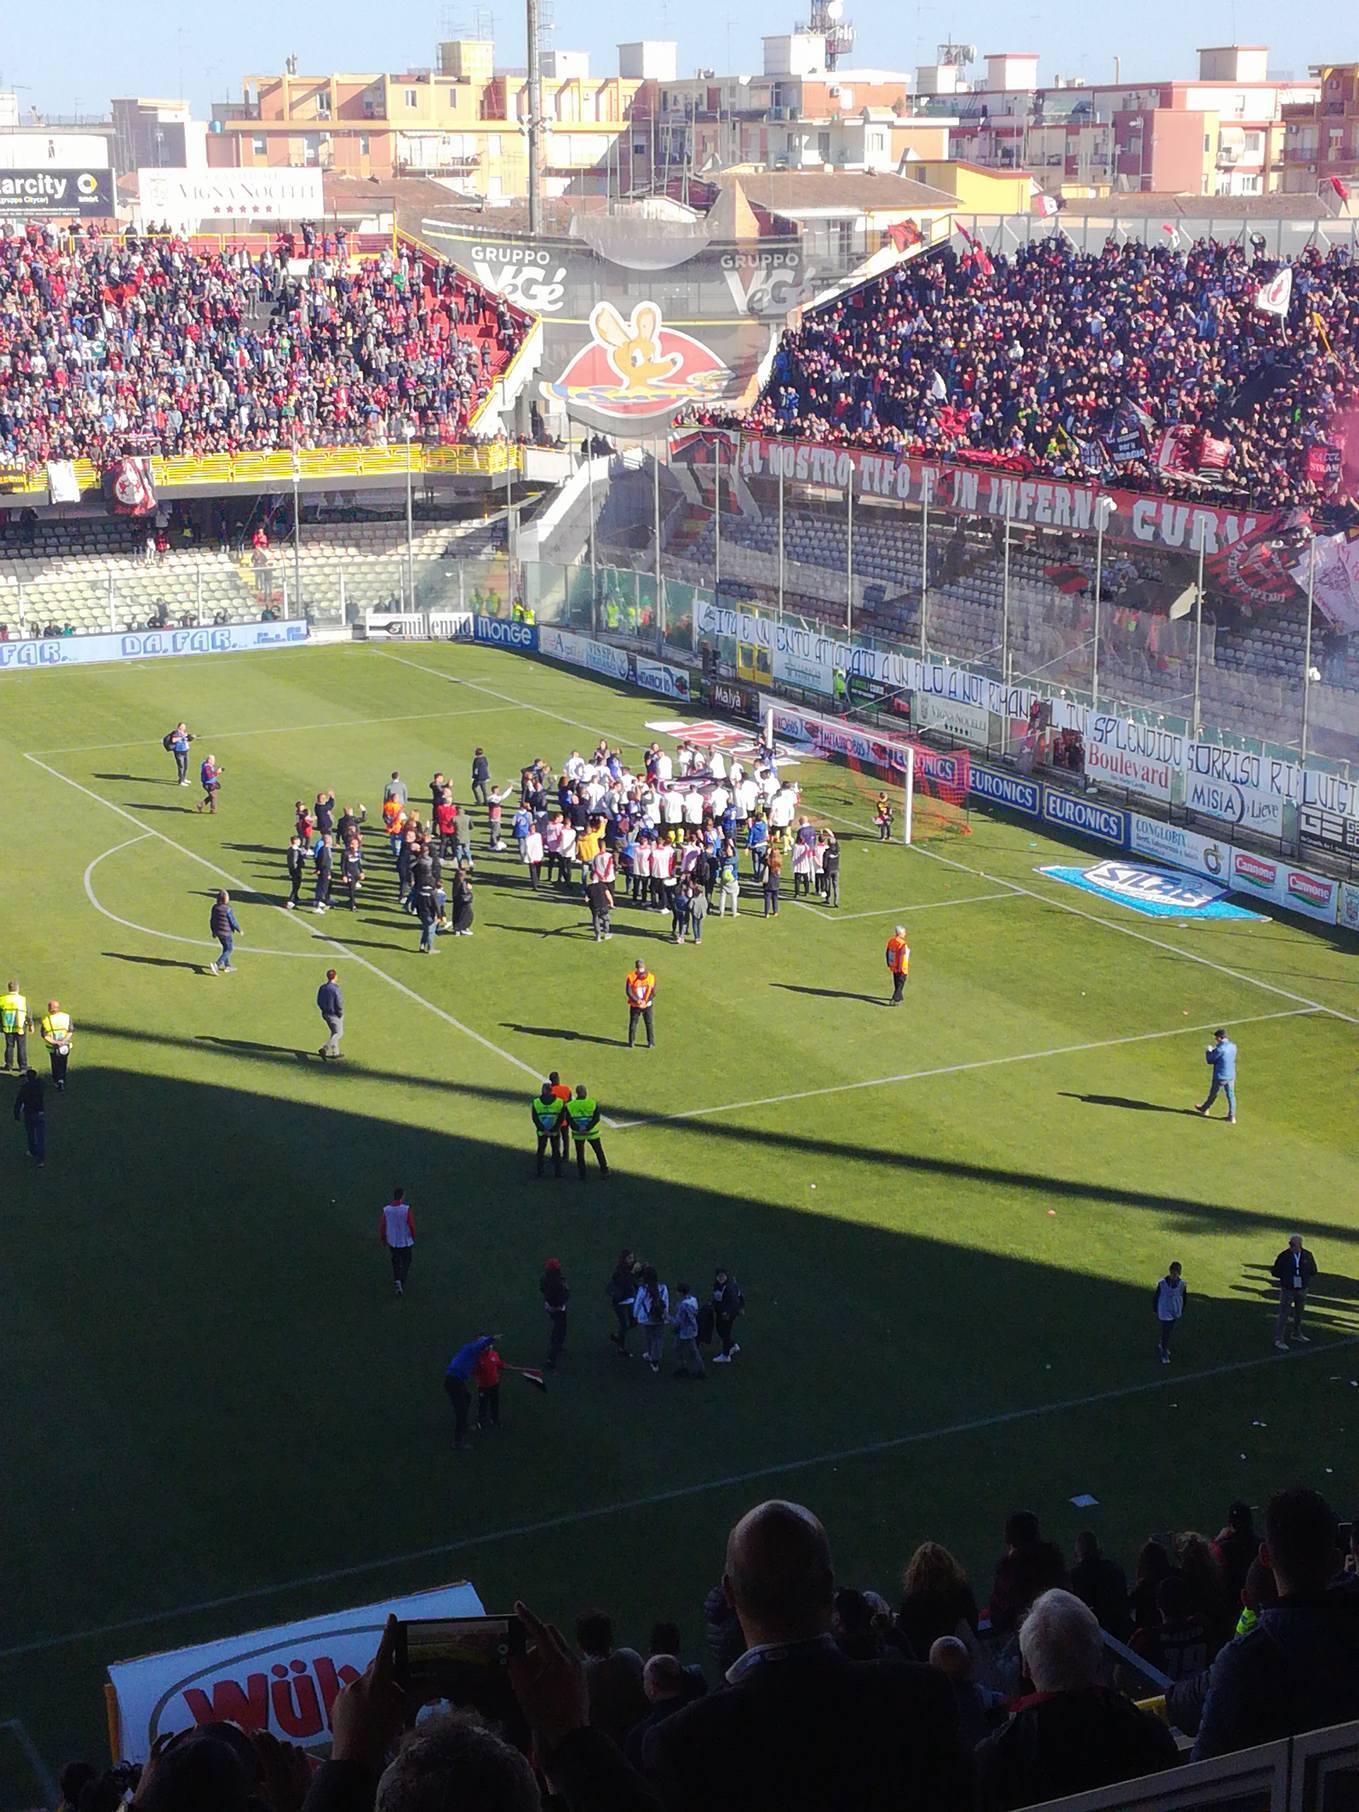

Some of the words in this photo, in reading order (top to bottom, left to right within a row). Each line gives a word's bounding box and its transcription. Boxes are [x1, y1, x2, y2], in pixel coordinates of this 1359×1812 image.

[0, 173, 67, 199] arcity
[471, 246, 550, 265] GRUPPO
[720, 253, 799, 268] GRUPPO
[764, 443, 852, 487] NOSTRO
[860, 455, 911, 498] TIFO
[989, 476, 1110, 531] INFERNO
[1088, 742, 1169, 789] Boulevard
[1093, 716, 1182, 766] SPLENDIDO
[1187, 744, 1260, 788] SORRISO
[1302, 771, 1357, 817] LUIGI
[969, 768, 1034, 807] EURONICS
[1191, 783, 1236, 816] MISIA
[1049, 796, 1119, 836] EURONICS
[1251, 799, 1280, 819] Lieve
